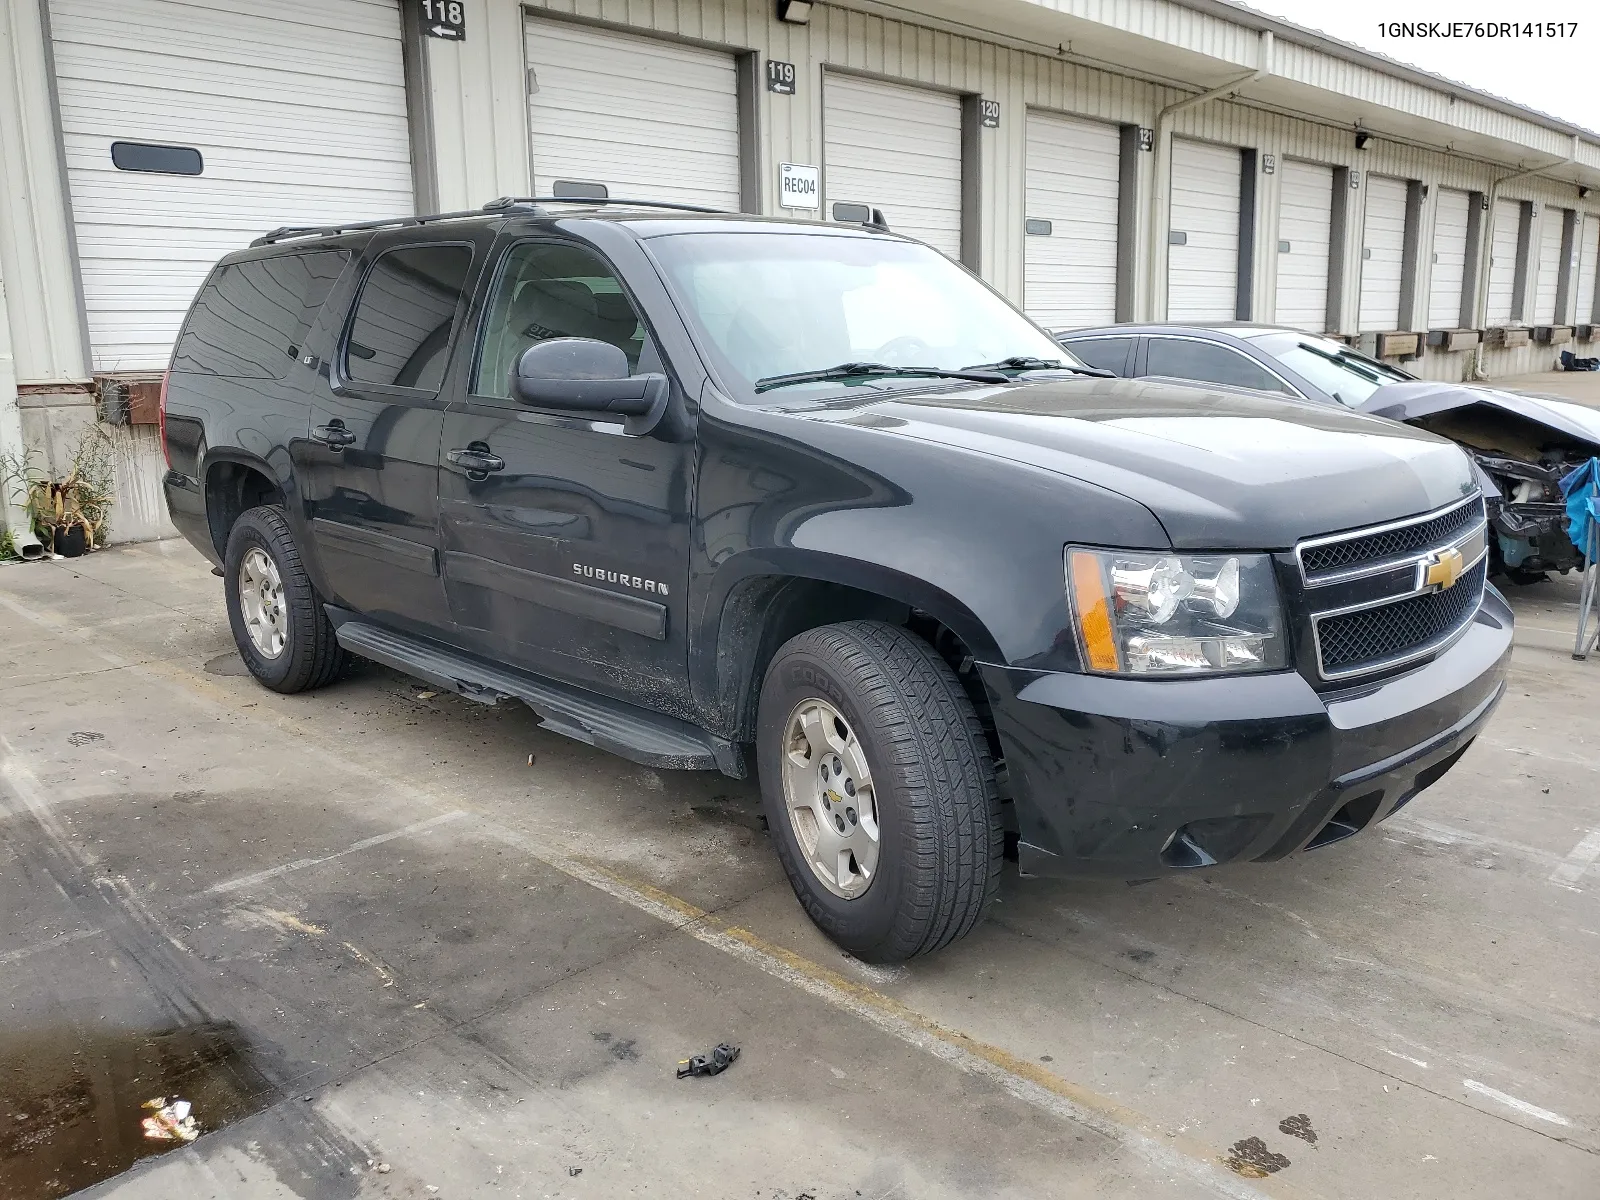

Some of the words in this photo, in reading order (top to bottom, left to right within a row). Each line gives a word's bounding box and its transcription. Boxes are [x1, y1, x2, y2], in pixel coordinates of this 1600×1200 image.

[422, 0, 462, 25] 118
[768, 61, 794, 82] 119
[981, 101, 999, 118] 120
[1140, 128, 1153, 142] 121
[784, 176, 816, 195] REC04
[572, 563, 670, 596] SUBURBAN
